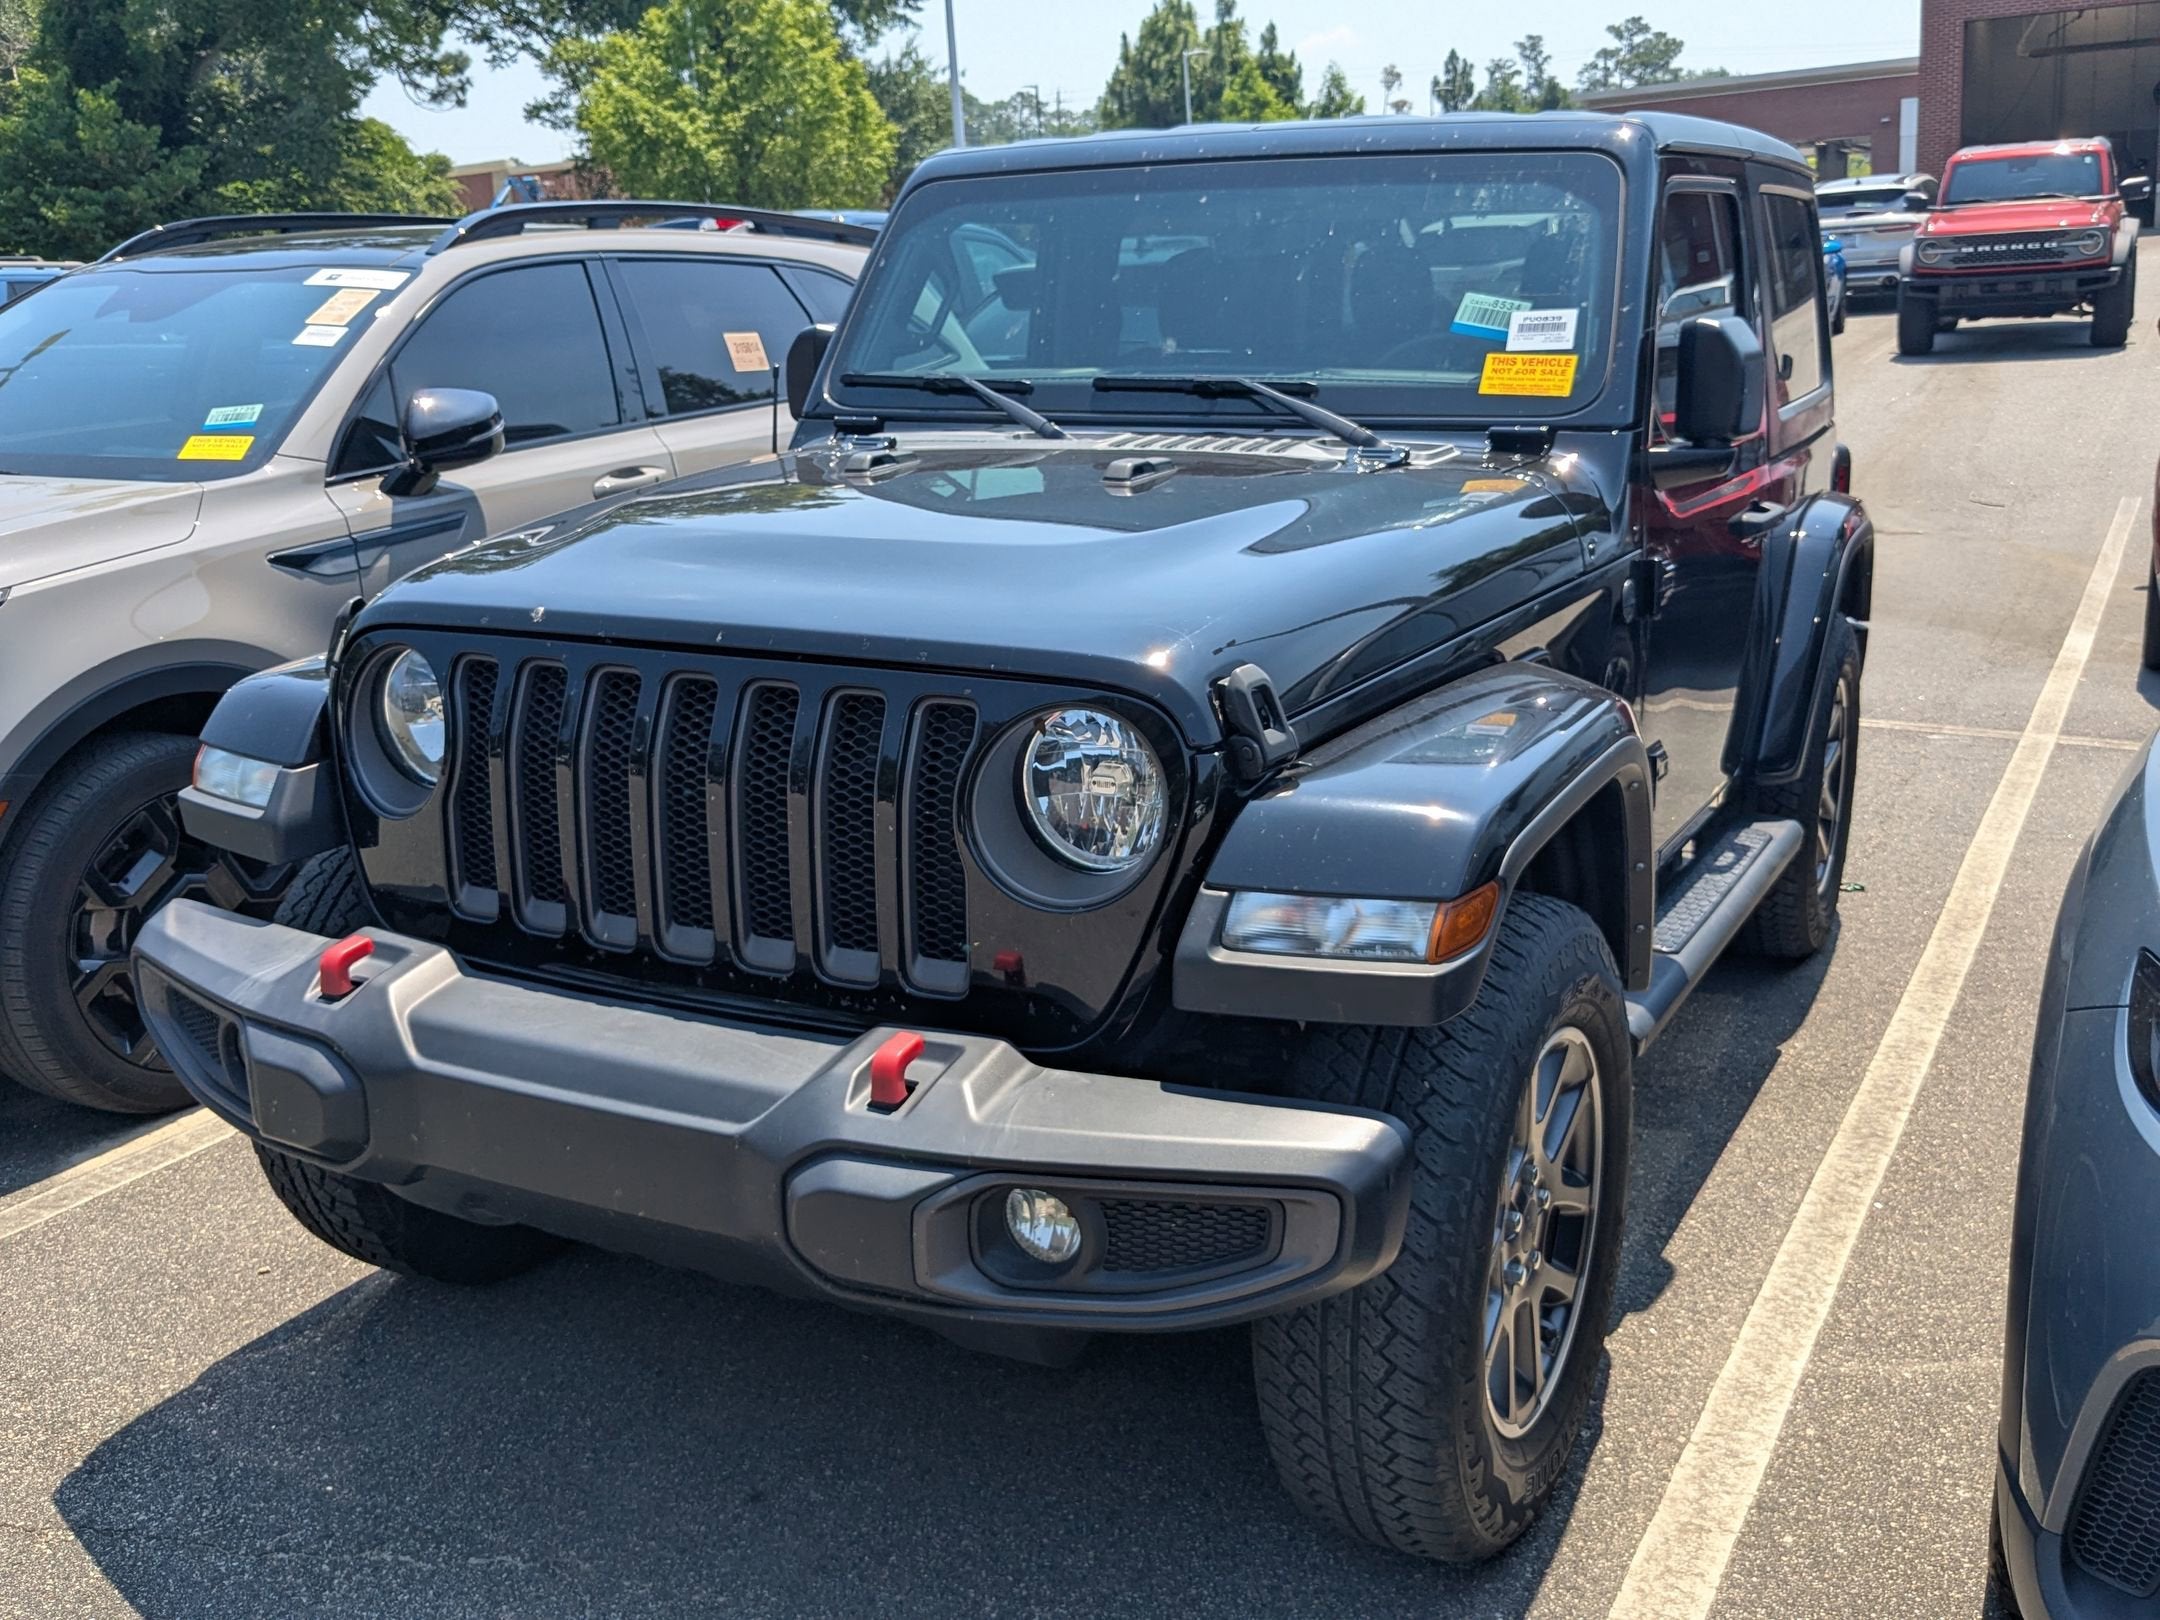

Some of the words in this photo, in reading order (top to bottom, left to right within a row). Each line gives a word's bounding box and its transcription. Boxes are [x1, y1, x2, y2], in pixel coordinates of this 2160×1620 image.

[1961, 242, 2057, 253] BRONCO
[1491, 357, 1517, 367] THIS
[1521, 357, 1572, 368] VEHICLE
[1514, 368, 1536, 376] FOR
[1539, 368, 1568, 377] SALE
